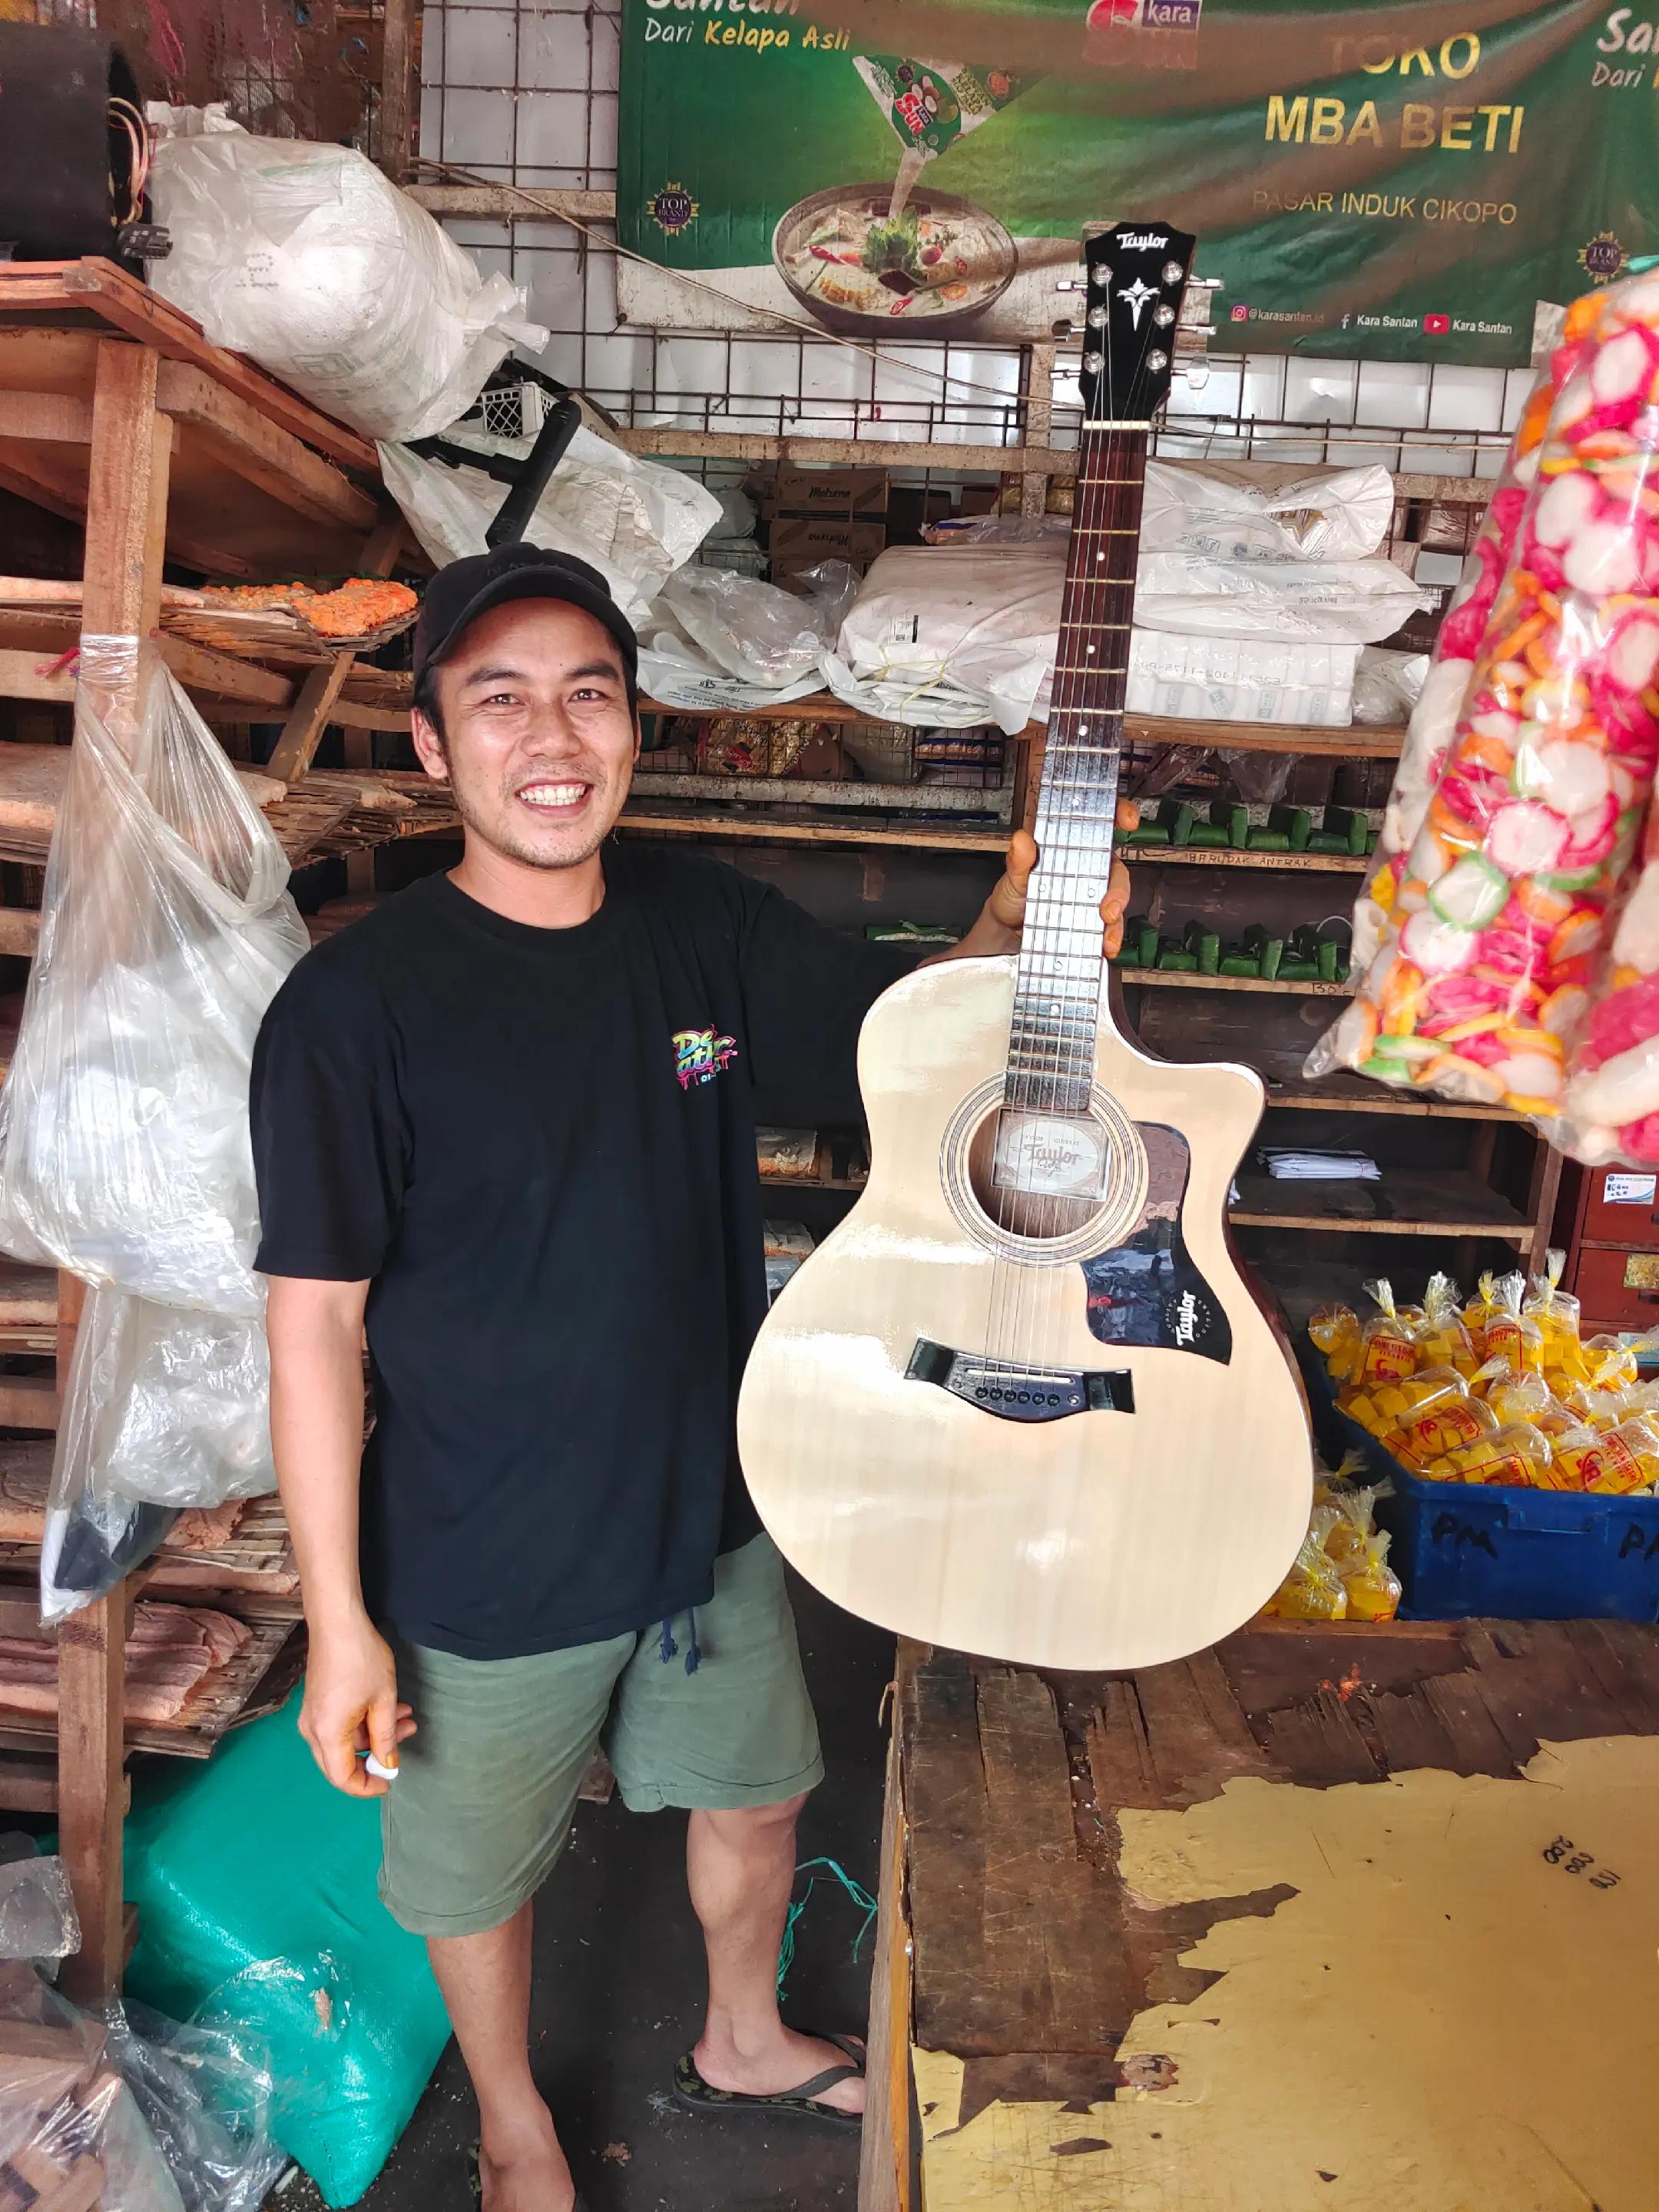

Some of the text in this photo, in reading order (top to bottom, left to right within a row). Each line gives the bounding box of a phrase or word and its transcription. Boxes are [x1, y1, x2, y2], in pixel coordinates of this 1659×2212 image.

[645, 17, 852, 55] Dari Kelapa Asli
[1597, 8, 1659, 55] Sa
[1591, 61, 1645, 88] Dari
[1265, 95, 1525, 154] MBA BETI
[659, 198, 687, 210] TOP
[1253, 190, 1518, 225] PASAR INDUK CIKOPO
[1116, 232, 1169, 252] Taylor
[1356, 314, 1418, 329] Kara Santan
[1452, 319, 1512, 334] Kara Santan
[1189, 853, 1311, 867] BARUDAK ANTRAK
[1023, 1144, 1079, 1165] Taylor
[1176, 1290, 1198, 1346] Taylor
